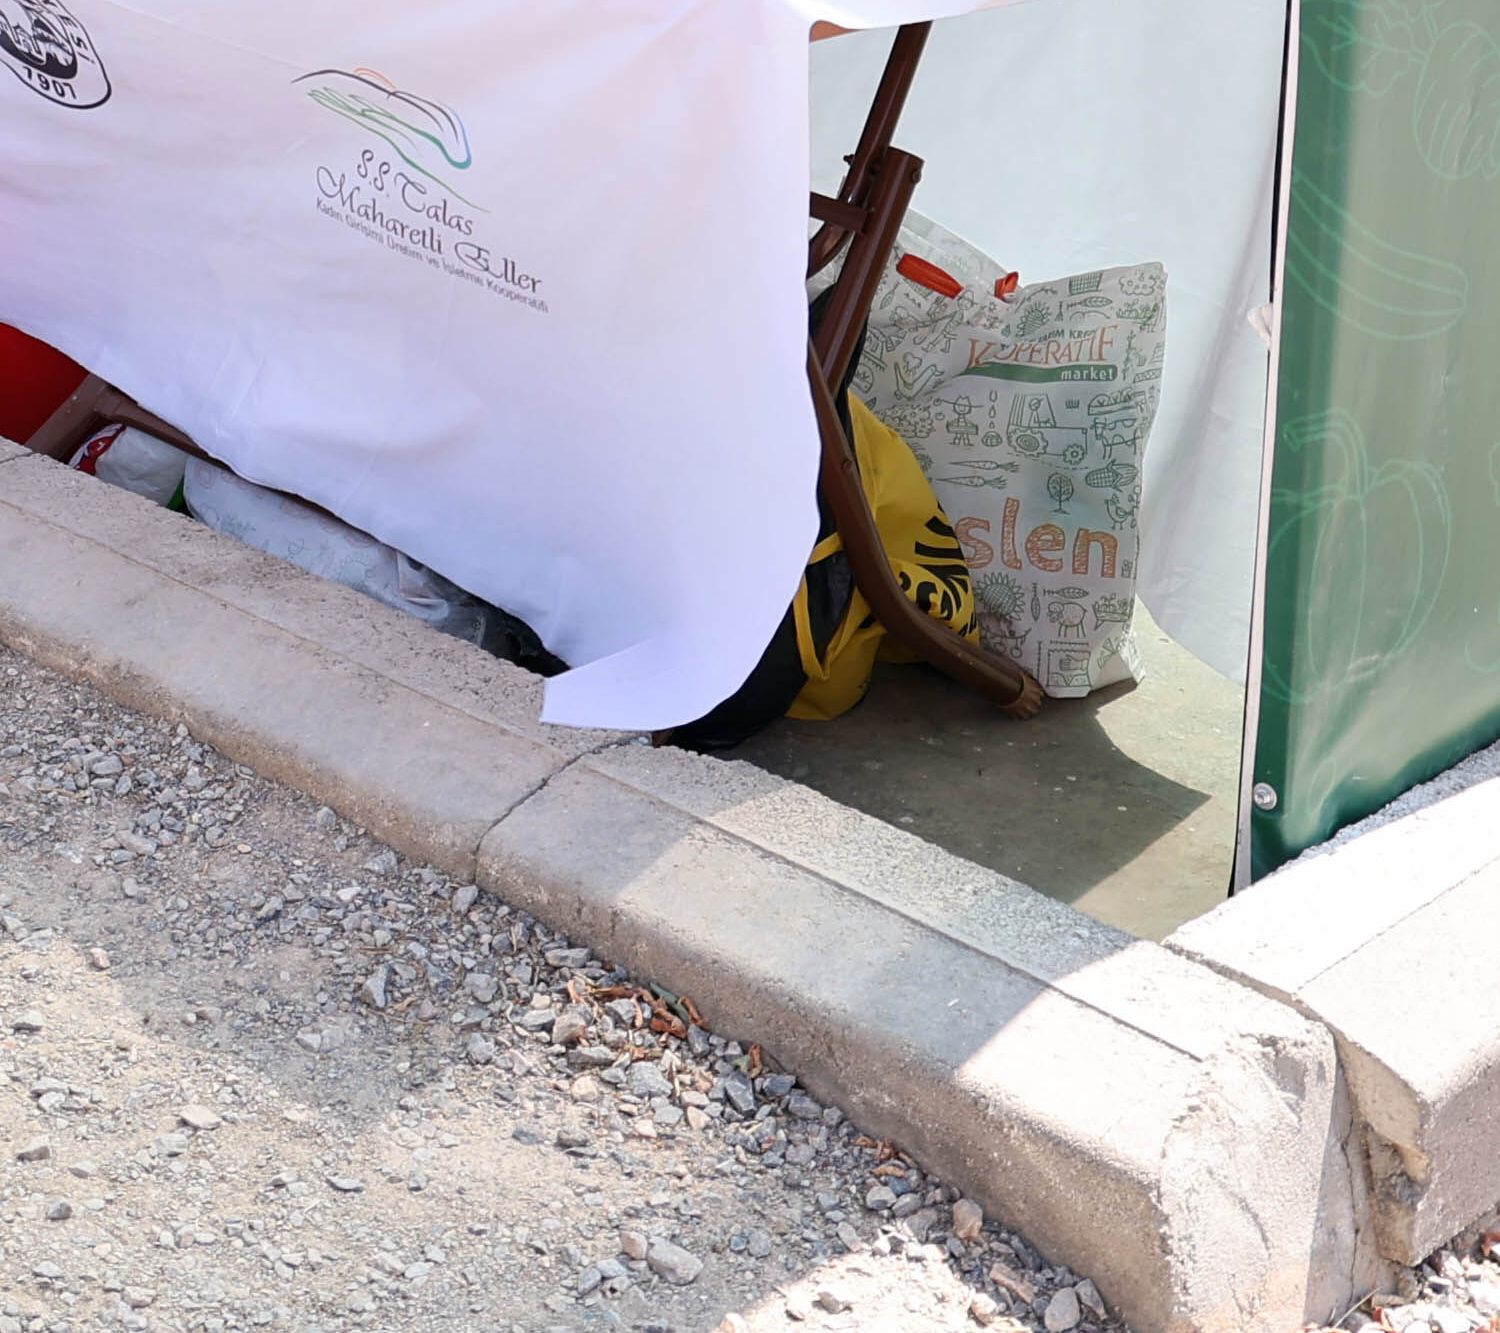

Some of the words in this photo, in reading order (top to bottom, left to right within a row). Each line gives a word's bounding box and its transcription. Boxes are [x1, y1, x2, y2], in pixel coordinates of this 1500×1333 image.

[22, 65, 77, 100] 1907
[394, 171, 474, 235] Talas
[316, 165, 442, 254] Maharetli
[454, 240, 544, 293] Eller
[1060, 365, 1116, 382] market
